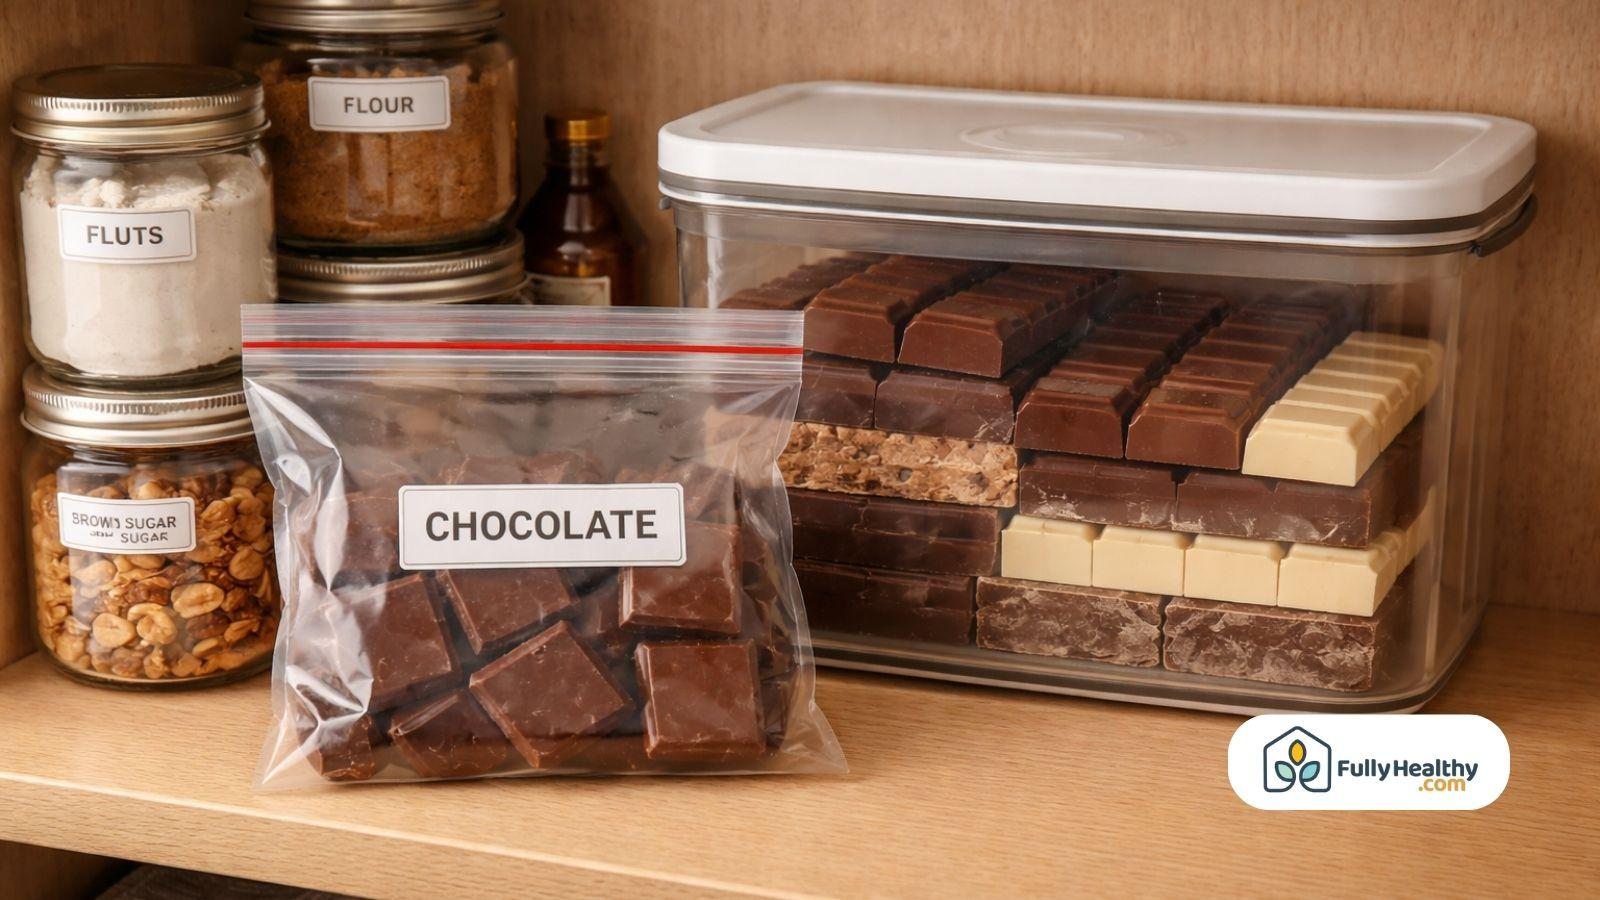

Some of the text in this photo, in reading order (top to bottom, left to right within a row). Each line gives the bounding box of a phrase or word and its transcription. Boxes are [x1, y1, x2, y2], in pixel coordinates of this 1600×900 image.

[343, 96, 415, 115] FLOUR
[86, 225, 164, 247] FLUTS
[125, 516, 177, 529] SUGAR
[425, 509, 658, 542] CHOCOLATE
